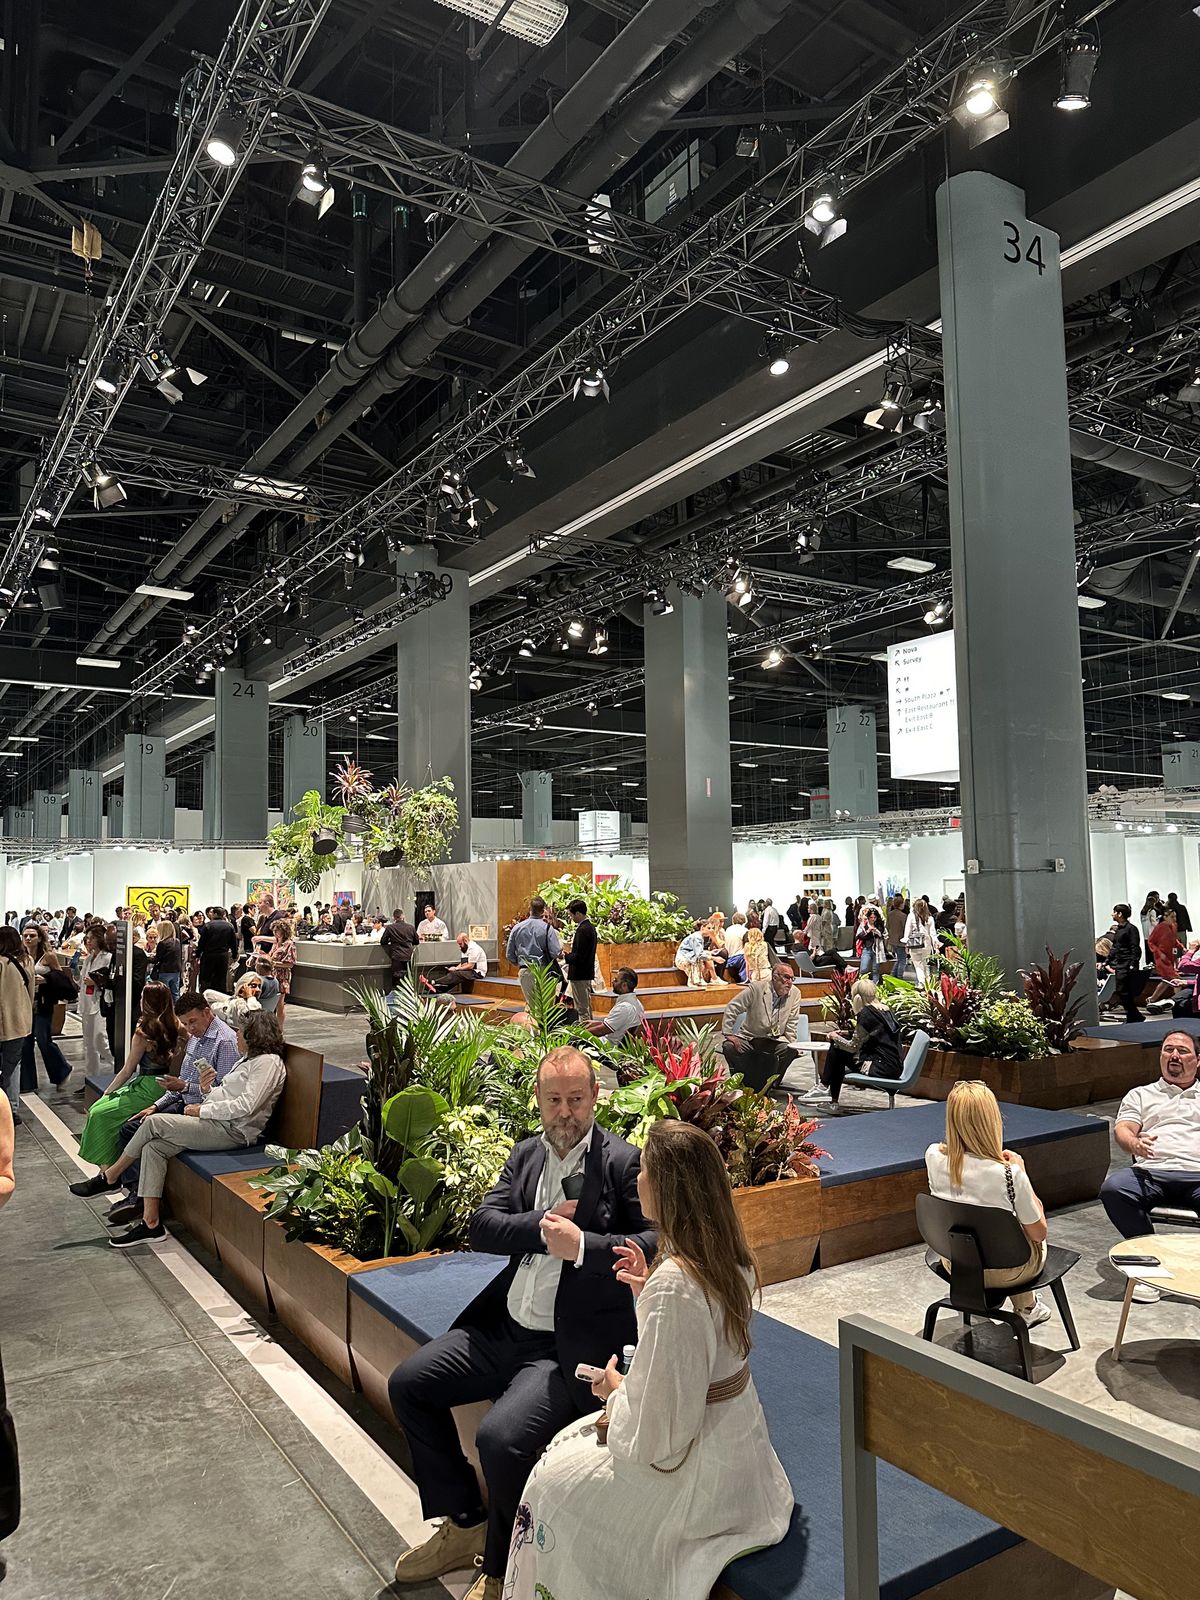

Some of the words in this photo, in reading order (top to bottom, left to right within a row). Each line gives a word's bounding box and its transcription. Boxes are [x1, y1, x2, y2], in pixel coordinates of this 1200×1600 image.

[1003, 220, 1046, 276] 34
[903, 646, 918, 654] Nova
[903, 656, 922, 666] Survey
[232, 682, 255, 698] 24
[860, 714, 870, 726] 22
[303, 725, 318, 737] 20
[836, 722, 847, 733] 22
[139, 743, 154, 754] 19
[1170, 754, 1181, 764] 21
[81, 776, 93, 786] 14
[43, 796, 56, 804] 09
